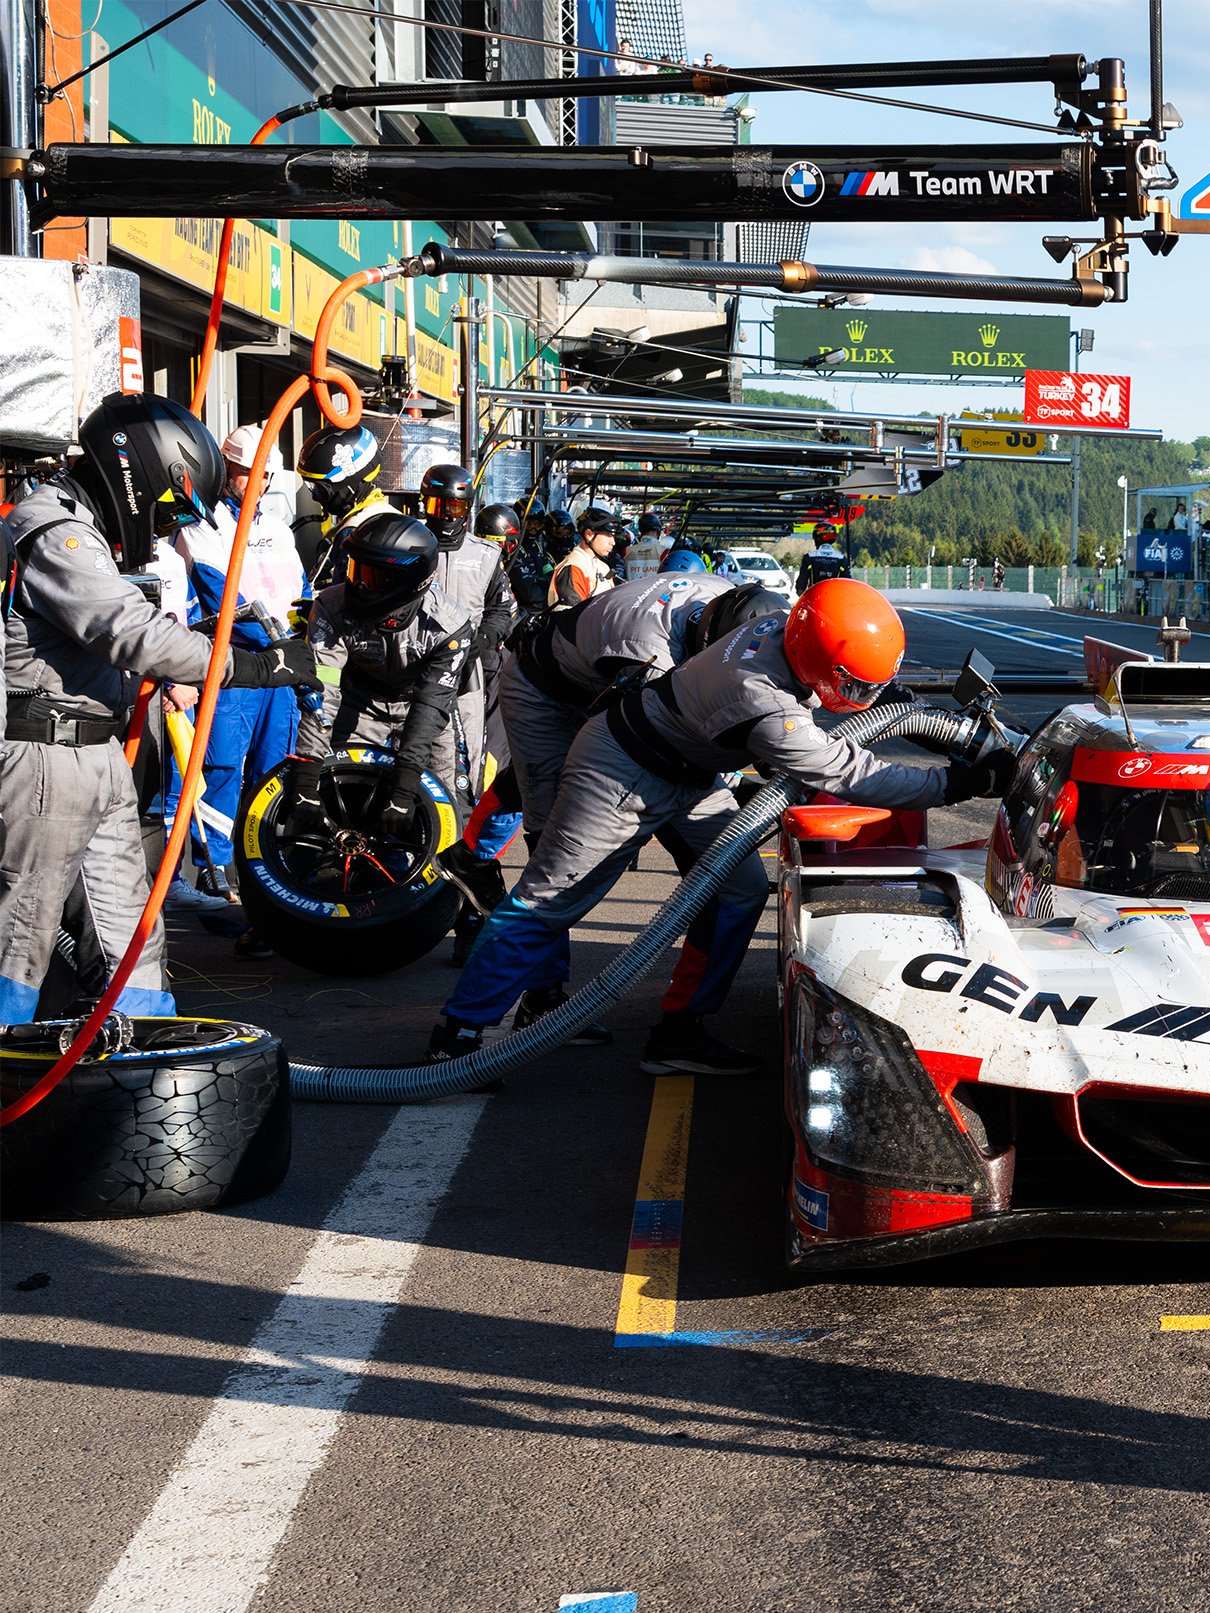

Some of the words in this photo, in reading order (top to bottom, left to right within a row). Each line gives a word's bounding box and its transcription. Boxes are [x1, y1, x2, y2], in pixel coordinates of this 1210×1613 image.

[909, 171, 982, 195] Team
[988, 169, 1054, 195] WRT
[271, 264, 281, 291] 34
[951, 350, 1027, 368] ROLEX
[1038, 392, 1075, 401] TURKEY
[1081, 382, 1122, 419] 34
[1050, 408, 1075, 417] SPORT
[122, 470, 140, 516] Motorsport
[1144, 548, 1162, 559] FIA
[630, 565, 641, 574] PIT
[642, 565, 659, 574] LANE
[265, 782, 277, 796] M
[254, 864, 317, 912] MICHELIN
[1104, 914, 1146, 933] FIA
[901, 952, 1098, 1026] GEN
